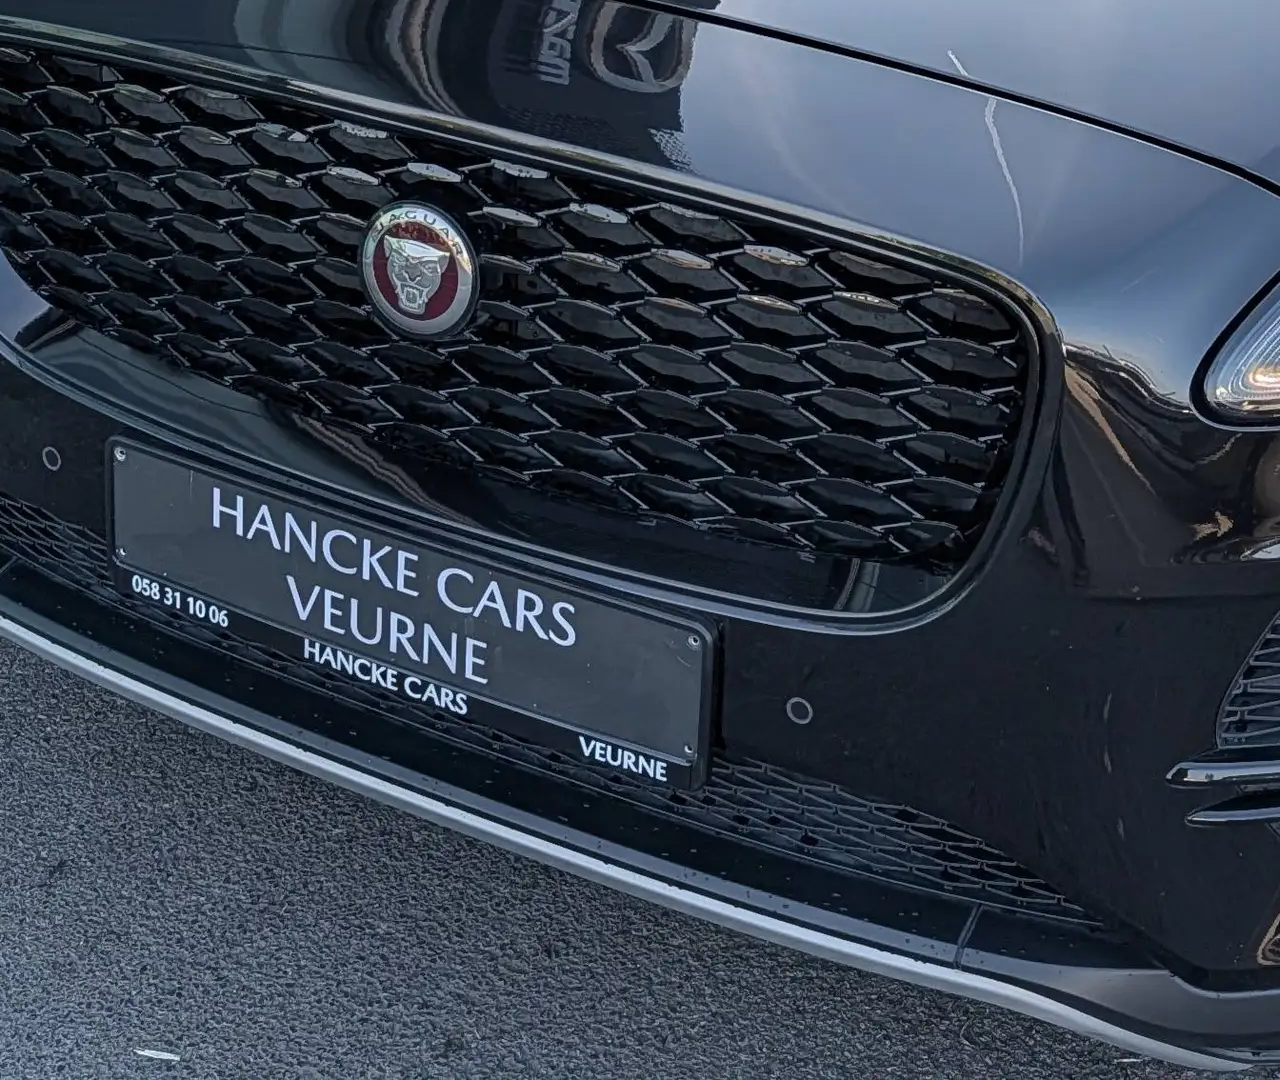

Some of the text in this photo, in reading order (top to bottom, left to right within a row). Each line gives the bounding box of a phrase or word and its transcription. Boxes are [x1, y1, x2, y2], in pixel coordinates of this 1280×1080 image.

[131, 574, 229, 627] 058 31 10 06
[212, 486, 576, 647] HANCKE CARS
[286, 575, 488, 685] VEURNE
[304, 638, 468, 715] HANCKE CARS
[579, 736, 667, 782] VEURNE
